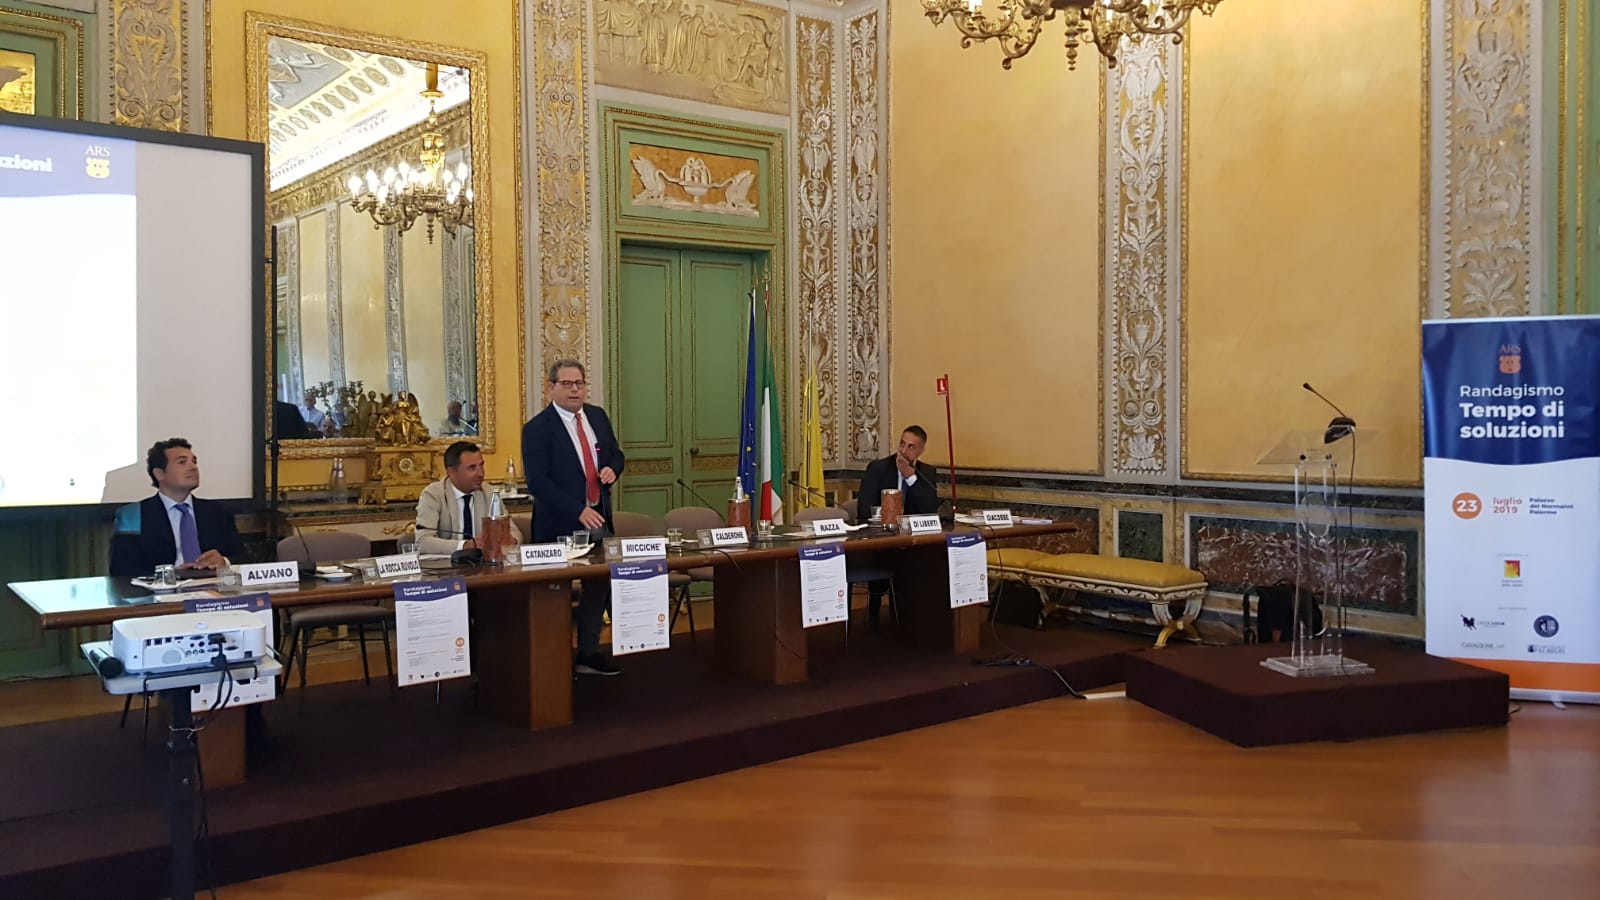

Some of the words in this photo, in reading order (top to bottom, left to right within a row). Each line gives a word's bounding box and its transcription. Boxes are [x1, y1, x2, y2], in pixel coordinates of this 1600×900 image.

[85, 145, 110, 157] ARS
[1499, 344, 1521, 353] ARS
[1460, 384, 1564, 399] Randagismo
[1459, 402, 1536, 420] Tempo
[1542, 401, 1564, 417] di
[1460, 421, 1564, 438] soluzioni
[1456, 499, 1478, 512] 23
[1493, 497, 1522, 506] luglio
[1493, 506, 1518, 514] 2019
[820, 523, 840, 531] RAZZA
[920, 520, 939, 528] LIBERTI
[715, 532, 744, 541] CALDERONE
[525, 548, 562, 559] CATANZARO
[247, 567, 293, 581] ALVANO
